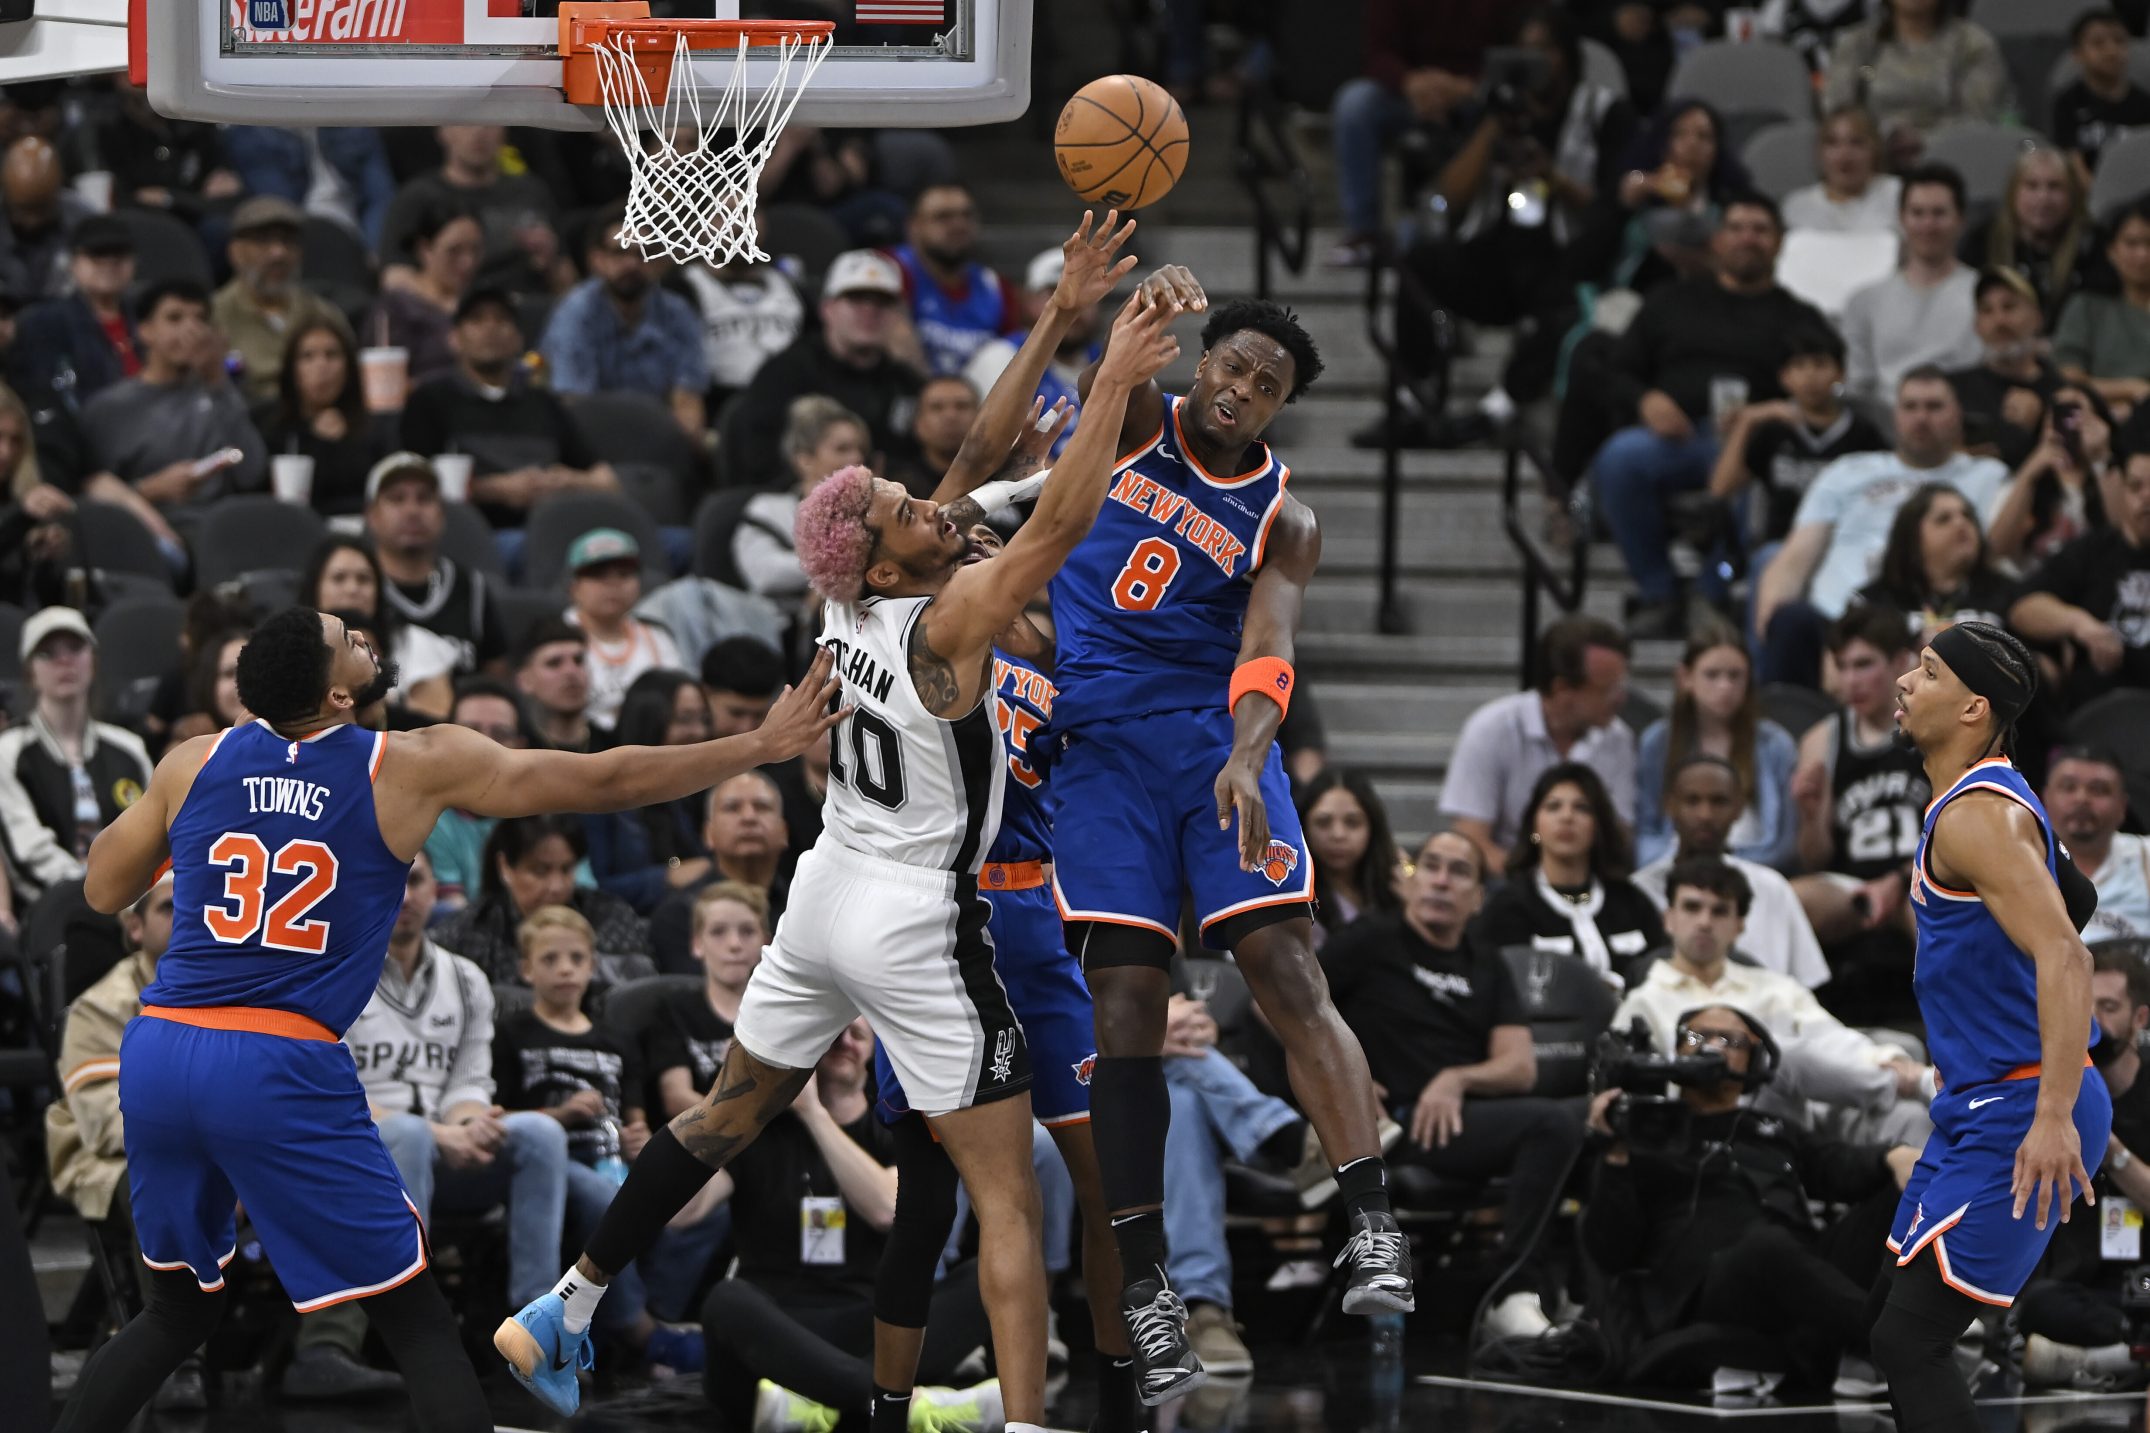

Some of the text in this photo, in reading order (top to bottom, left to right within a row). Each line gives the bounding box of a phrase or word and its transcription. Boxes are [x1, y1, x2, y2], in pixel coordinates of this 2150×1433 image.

[253, 2, 279, 22] NBA
[1107, 468, 1248, 579] NEW YORK
[1111, 536, 1182, 611] 8
[825, 638, 895, 704] CHAN
[1276, 671, 1289, 691] 8
[829, 687, 910, 814] 10
[242, 776, 331, 822] TOWNS
[1848, 804, 1920, 861] 21
[203, 831, 340, 955] 32
[354, 1040, 458, 1080] SPURS
